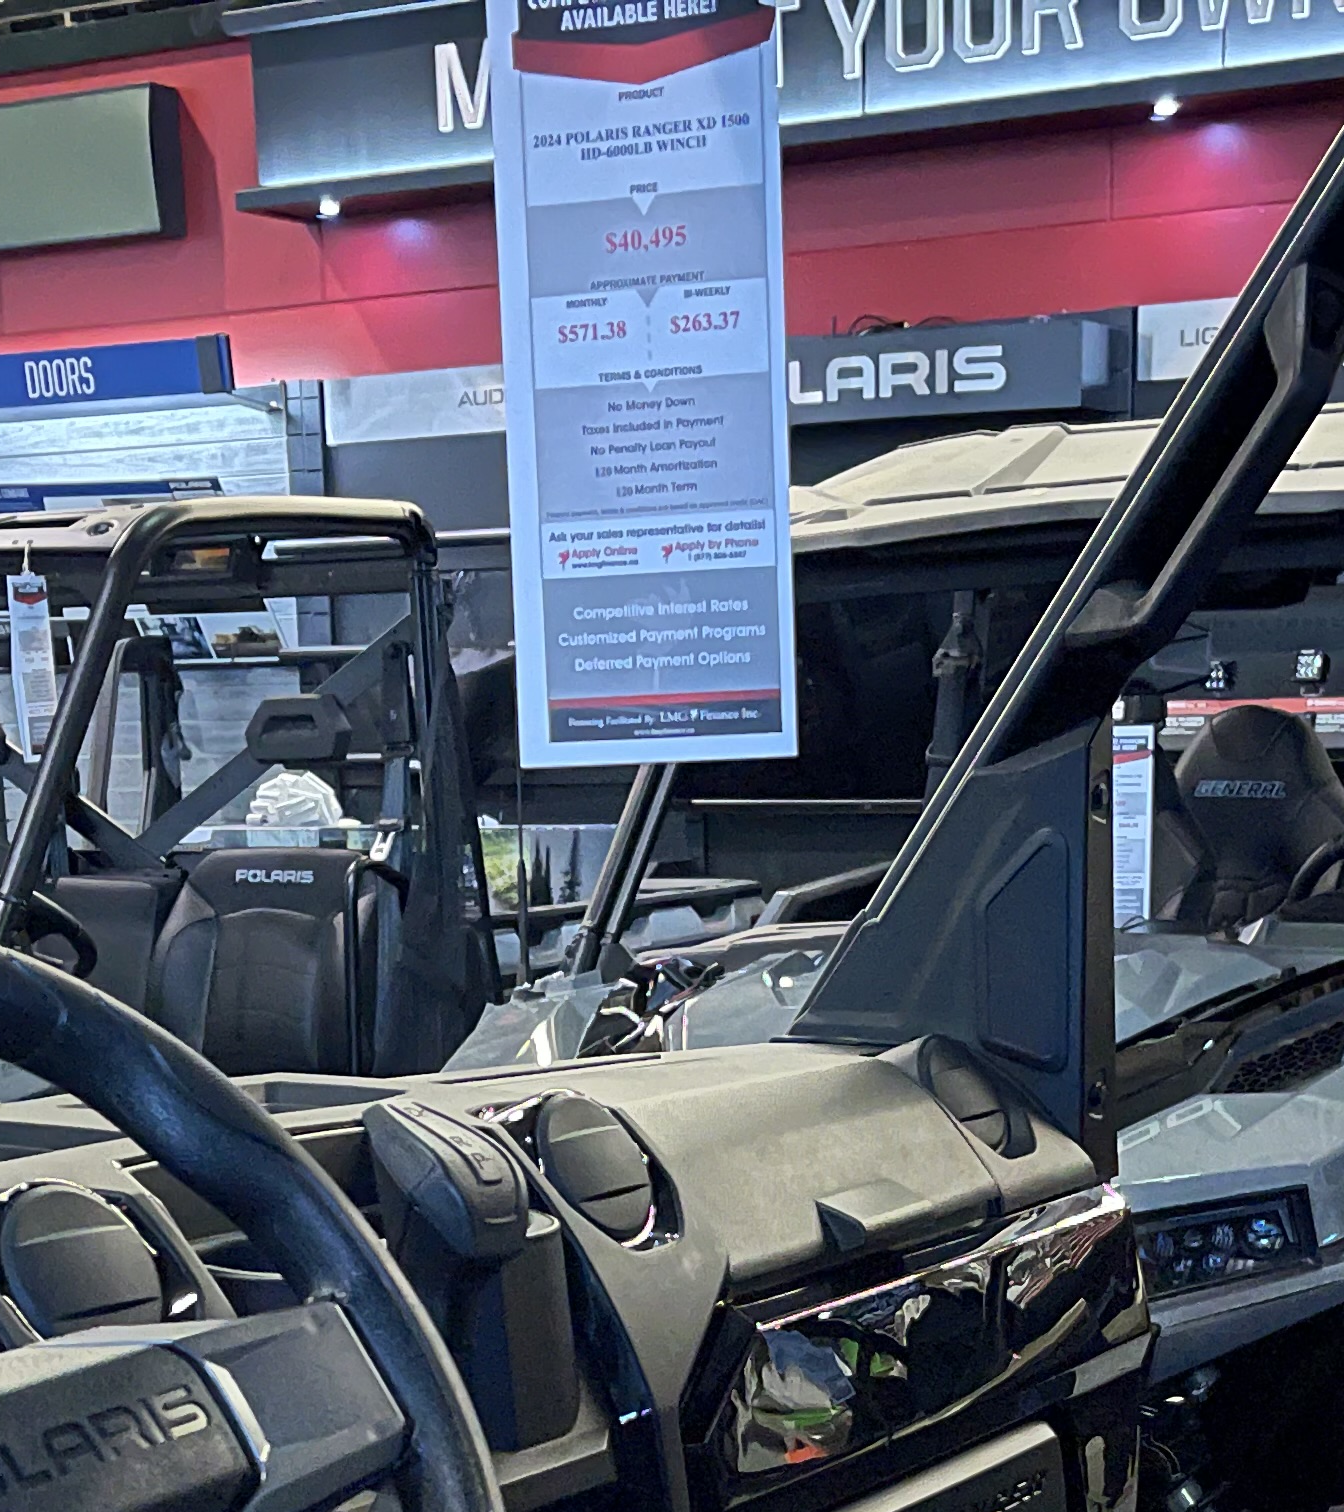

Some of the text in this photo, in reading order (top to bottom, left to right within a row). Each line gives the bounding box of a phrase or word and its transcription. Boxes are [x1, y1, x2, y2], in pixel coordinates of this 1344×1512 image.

[561, 4, 657, 31] AVAILABLE
[618, 87, 664, 101] PRODUCT
[533, 113, 750, 148] 2024 POLARIS RANGER XD 1500
[656, 134, 707, 152] WINCH
[630, 182, 658, 195] PRICE
[605, 224, 687, 254] $40,495
[590, 271, 705, 290] APPROXIMATE PAYMENT
[566, 286, 731, 309] MONTHLY BI-WEEKLY
[558, 310, 740, 344] $571.38 $263.37
[24, 356, 96, 399] DOORS
[598, 365, 702, 382] TERMS & CONDITIONS
[788, 345, 1007, 404] LARIS
[458, 388, 504, 408] AUD
[607, 395, 696, 413] No Money Down
[582, 424, 610, 436] Taxes
[612, 419, 661, 433] Included
[676, 414, 725, 431] Payment
[590, 436, 716, 456] No Penalty Loan Payout
[614, 462, 647, 475] Month
[649, 458, 718, 472] Amortization
[635, 482, 669, 495] Month
[671, 480, 698, 492] Term
[548, 532, 567, 543] Ask
[570, 532, 594, 543] your
[596, 529, 624, 539] sales
[626, 524, 704, 538] representative
[707, 522, 721, 532] for
[572, 537, 759, 560] Apply Online Apply by Phone
[573, 598, 749, 621] Competitive Interest Rates
[558, 623, 766, 647] Customized Payment Programs
[574, 650, 751, 671] Deferred Payment Options
[1193, 780, 1287, 799] GENERAL
[235, 868, 315, 885] POLARIS
